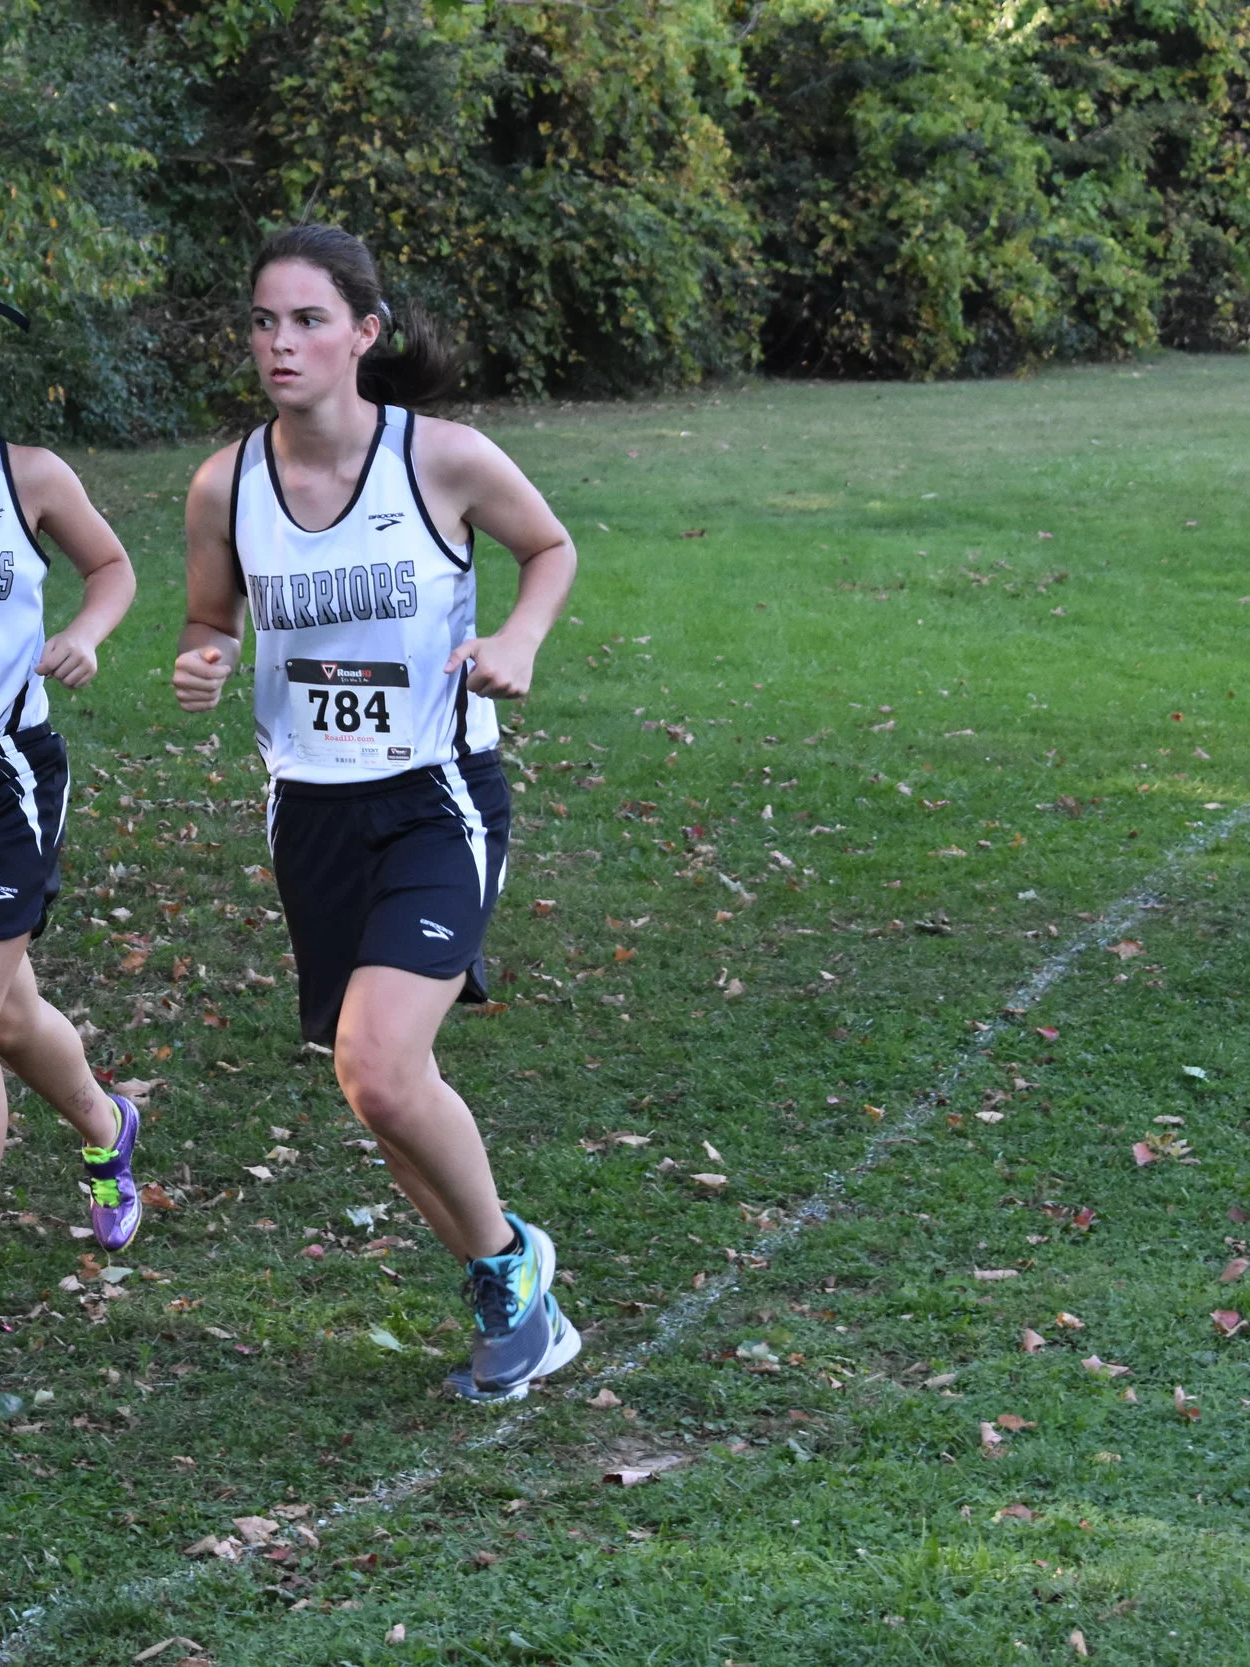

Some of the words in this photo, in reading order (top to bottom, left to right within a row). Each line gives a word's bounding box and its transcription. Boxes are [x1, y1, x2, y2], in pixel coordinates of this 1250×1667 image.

[247, 560, 418, 631] WARRIORS
[308, 689, 391, 733] 784
[324, 733, 375, 743] RoadID.com
